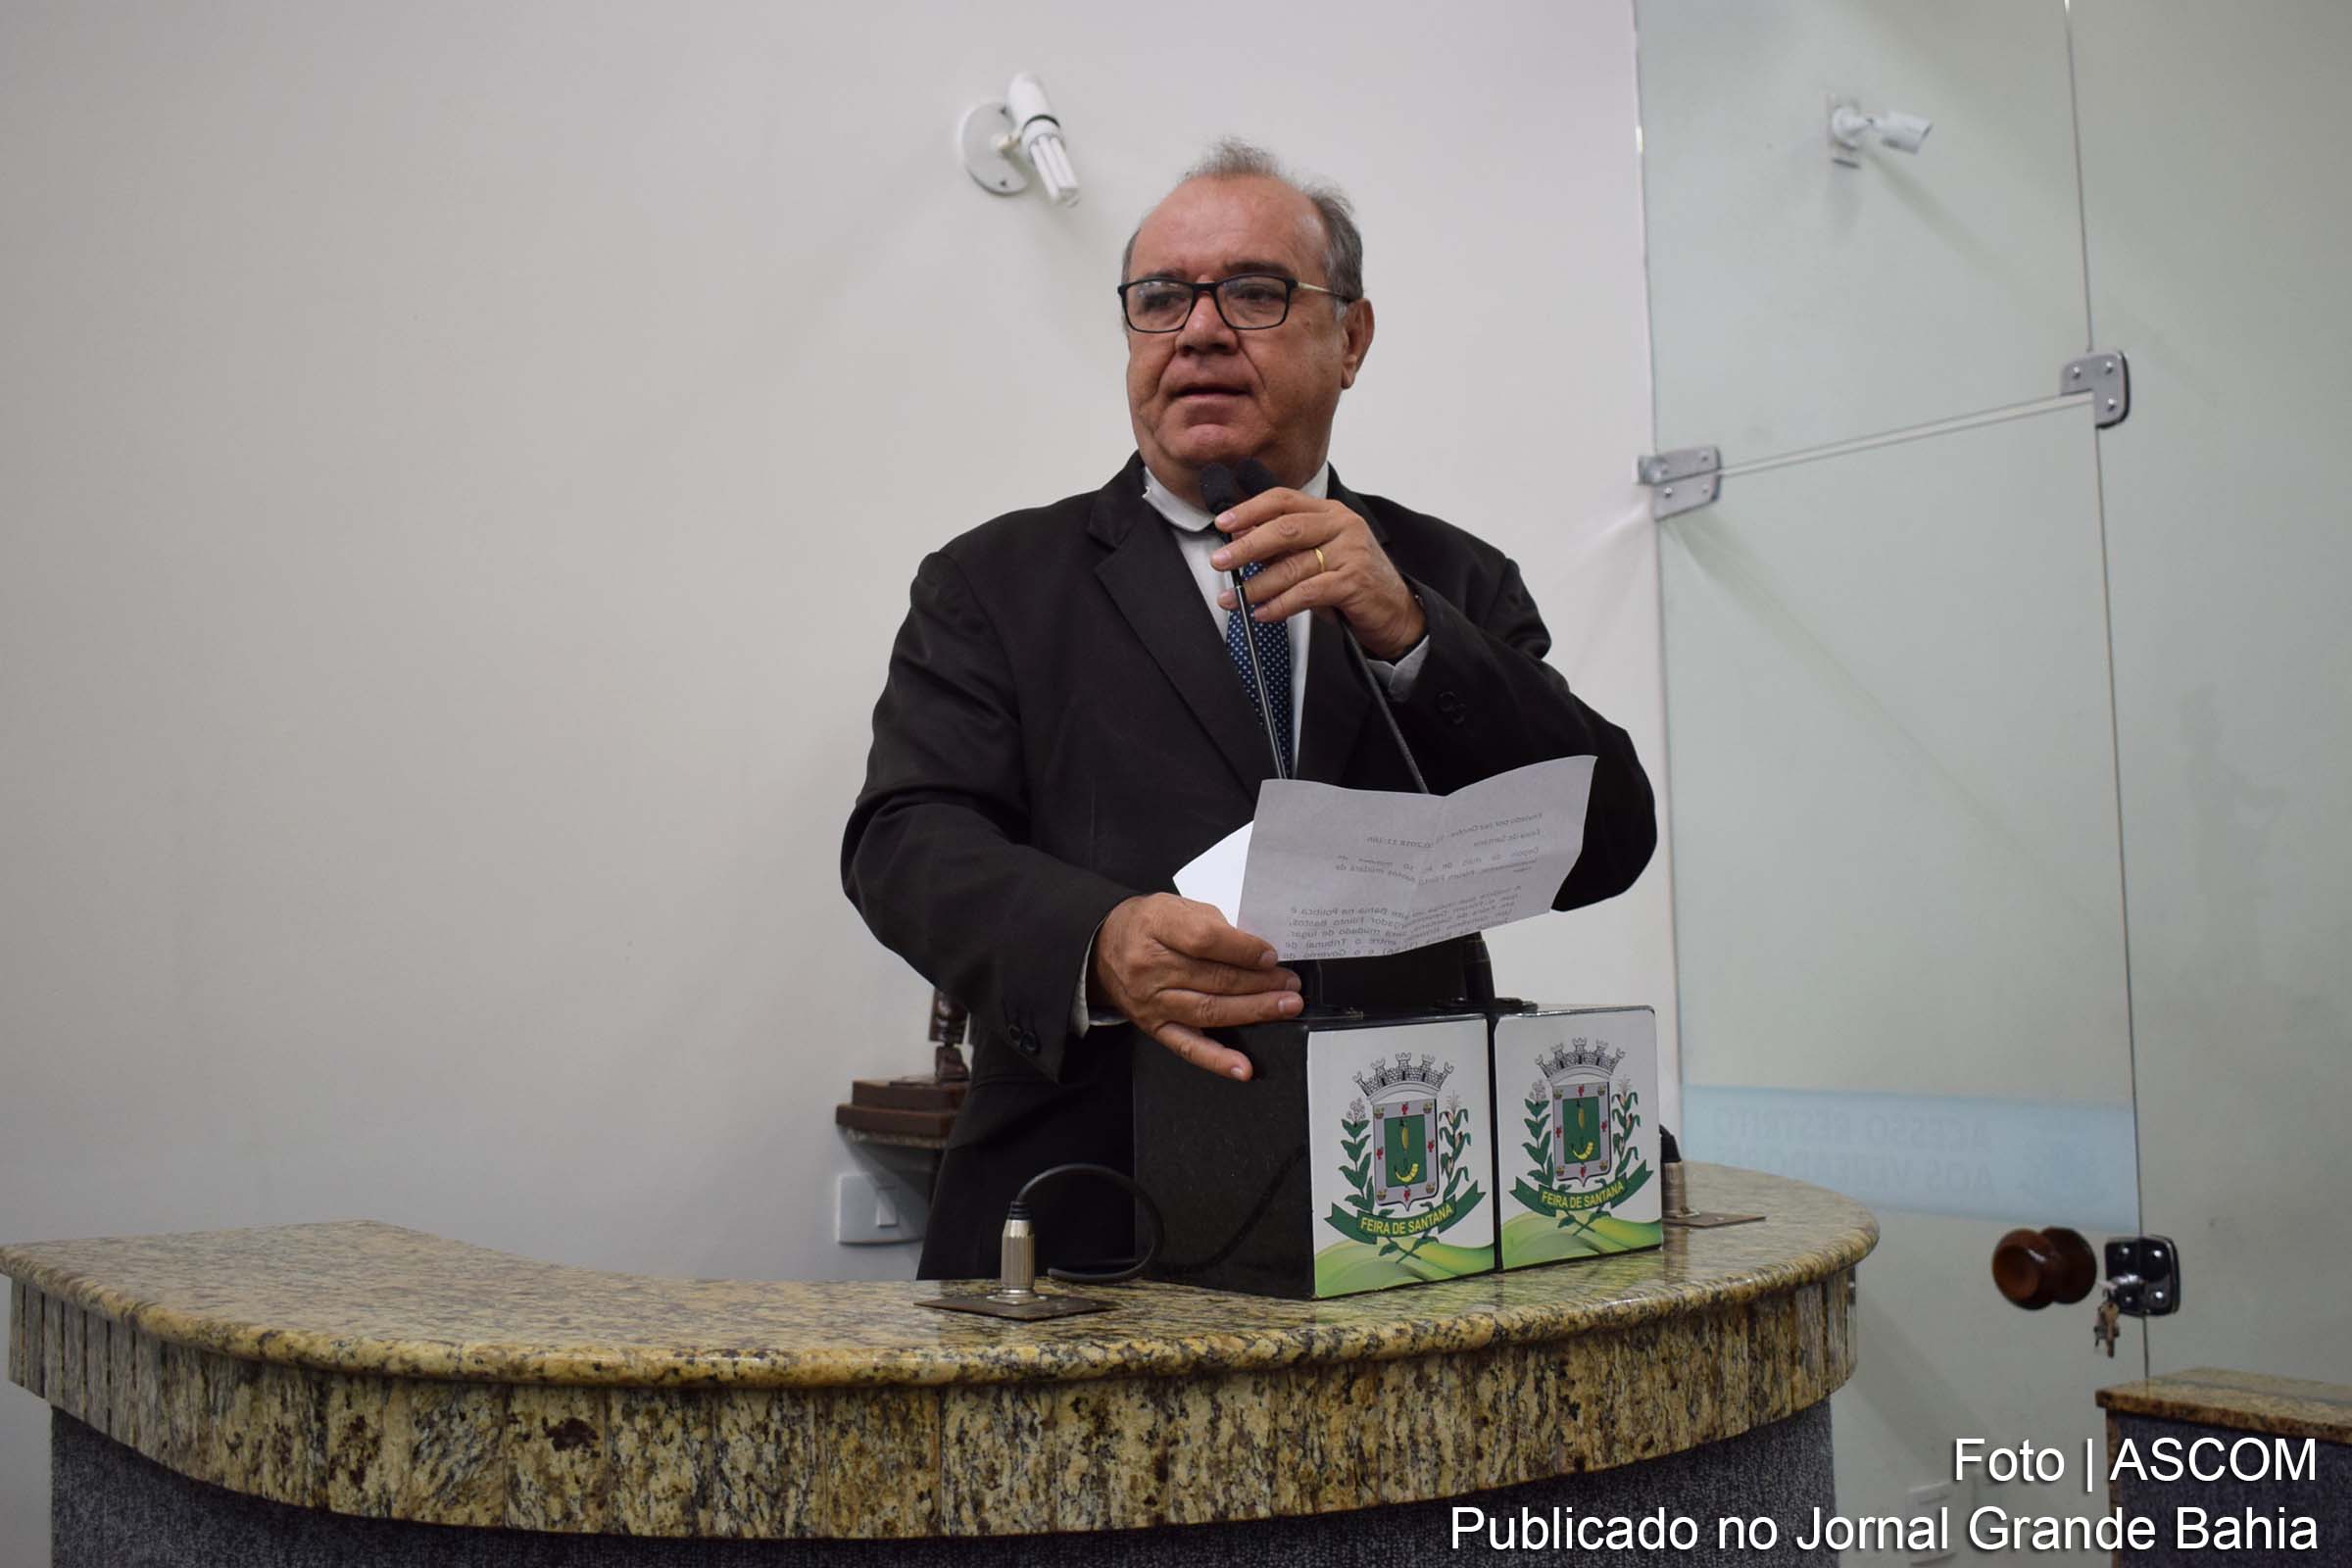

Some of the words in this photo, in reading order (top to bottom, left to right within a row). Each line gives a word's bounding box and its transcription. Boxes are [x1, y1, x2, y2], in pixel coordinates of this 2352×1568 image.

[1542, 1192, 1568, 1207] FEIRA
[1570, 1197, 1582, 1207] DE
[1584, 1181, 1624, 1206] SANTANA
[1360, 1217, 1390, 1234] FEIRA
[1393, 1222, 1405, 1234] DE
[1407, 1204, 1453, 1232] SANTANA
